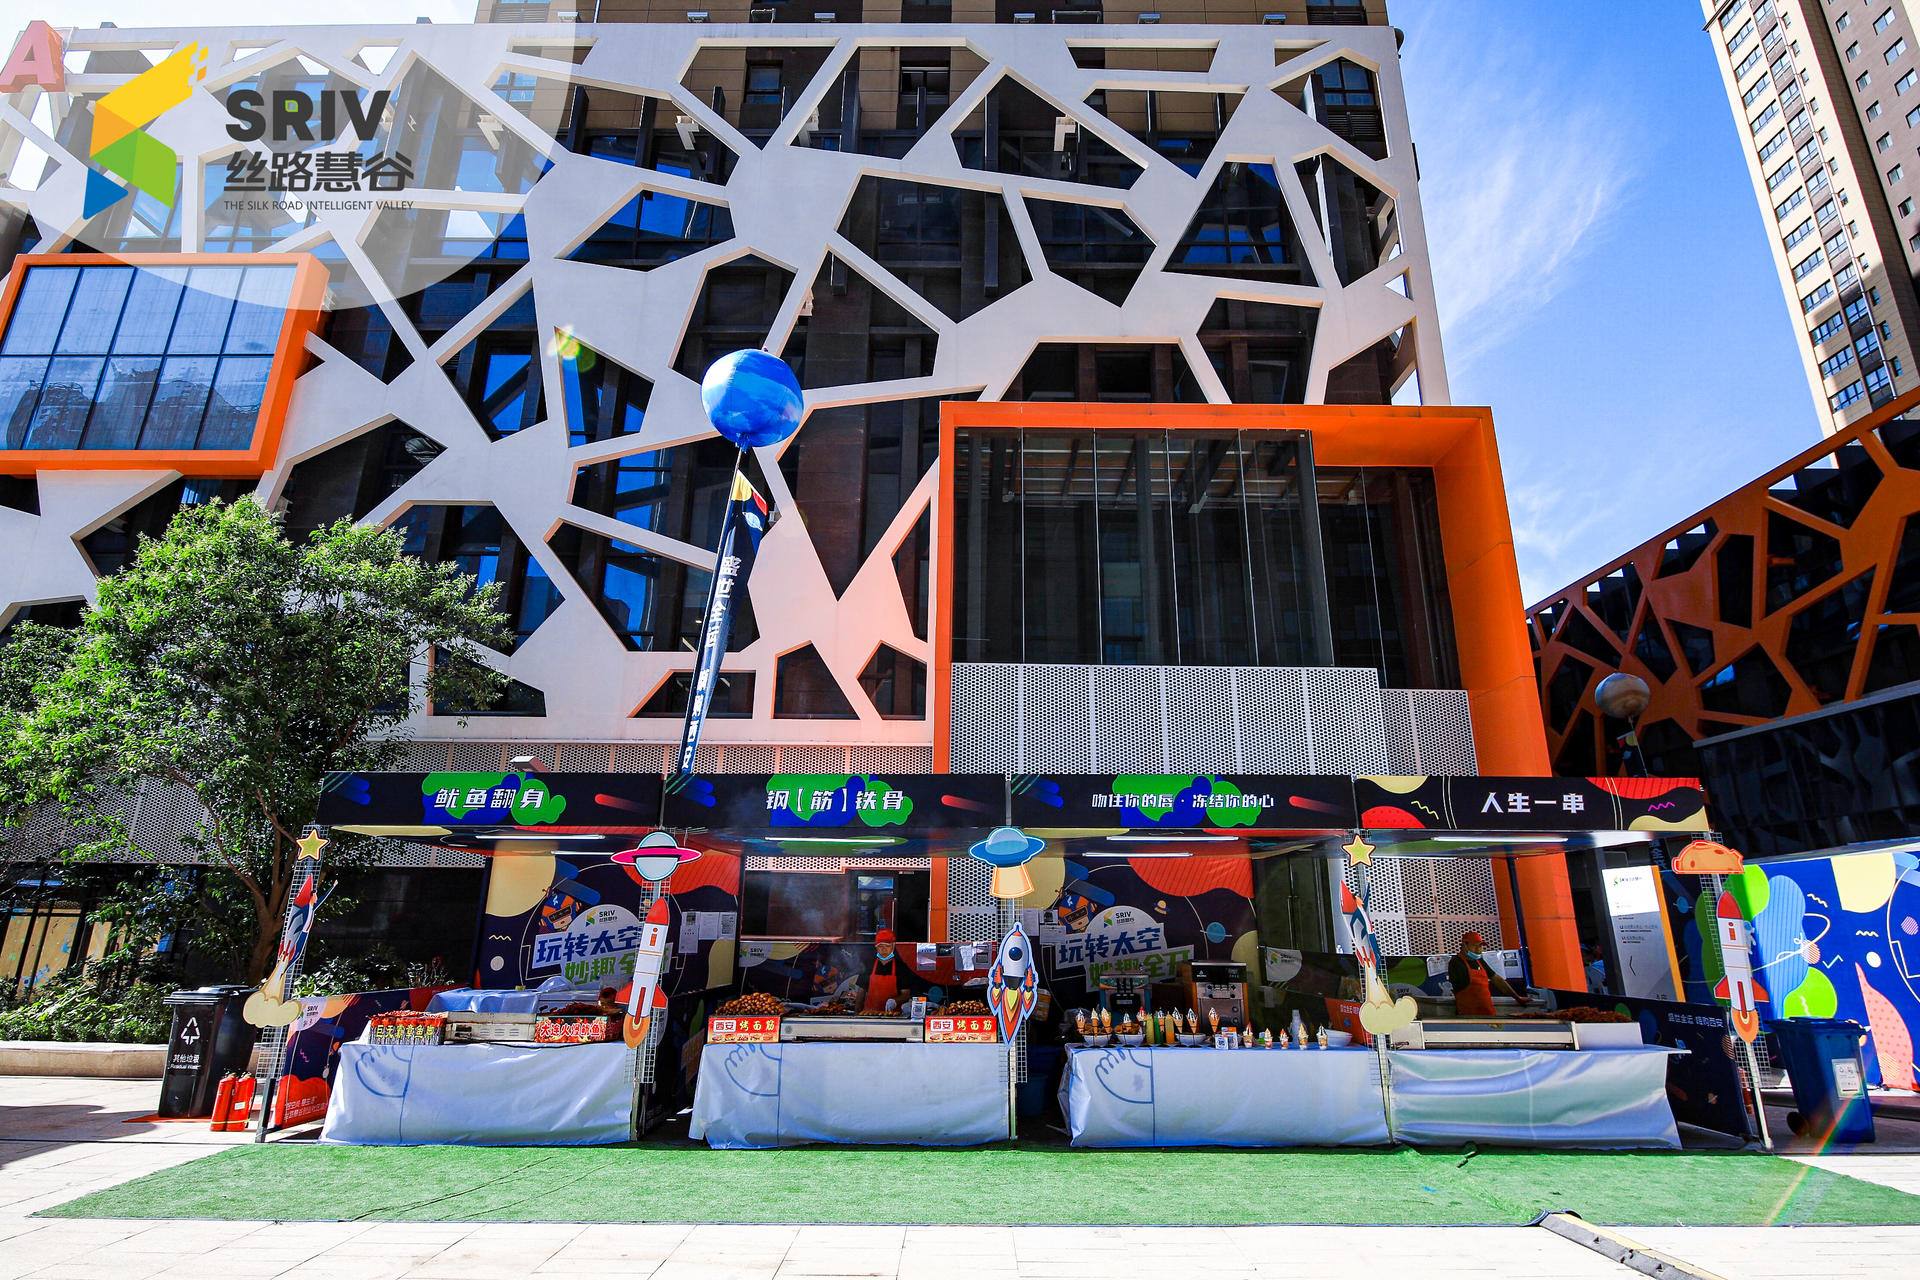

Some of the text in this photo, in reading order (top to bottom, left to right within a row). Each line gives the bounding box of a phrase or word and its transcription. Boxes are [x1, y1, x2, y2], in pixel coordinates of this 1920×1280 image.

[0, 20, 62, 92] A
[434, 787, 545, 809] 鱿鱼翻身
[765, 788, 905, 812] 钢【筋】铁骨
[1481, 791, 1585, 814] 人生一串
[536, 925, 644, 963] 玩转太空
[1058, 927, 1162, 963] 玩转太空
[739, 1019, 775, 1031] 烤面筋
[956, 1019, 993, 1031] 烤面筋
[173, 1054, 200, 1063] 其他垃圾
